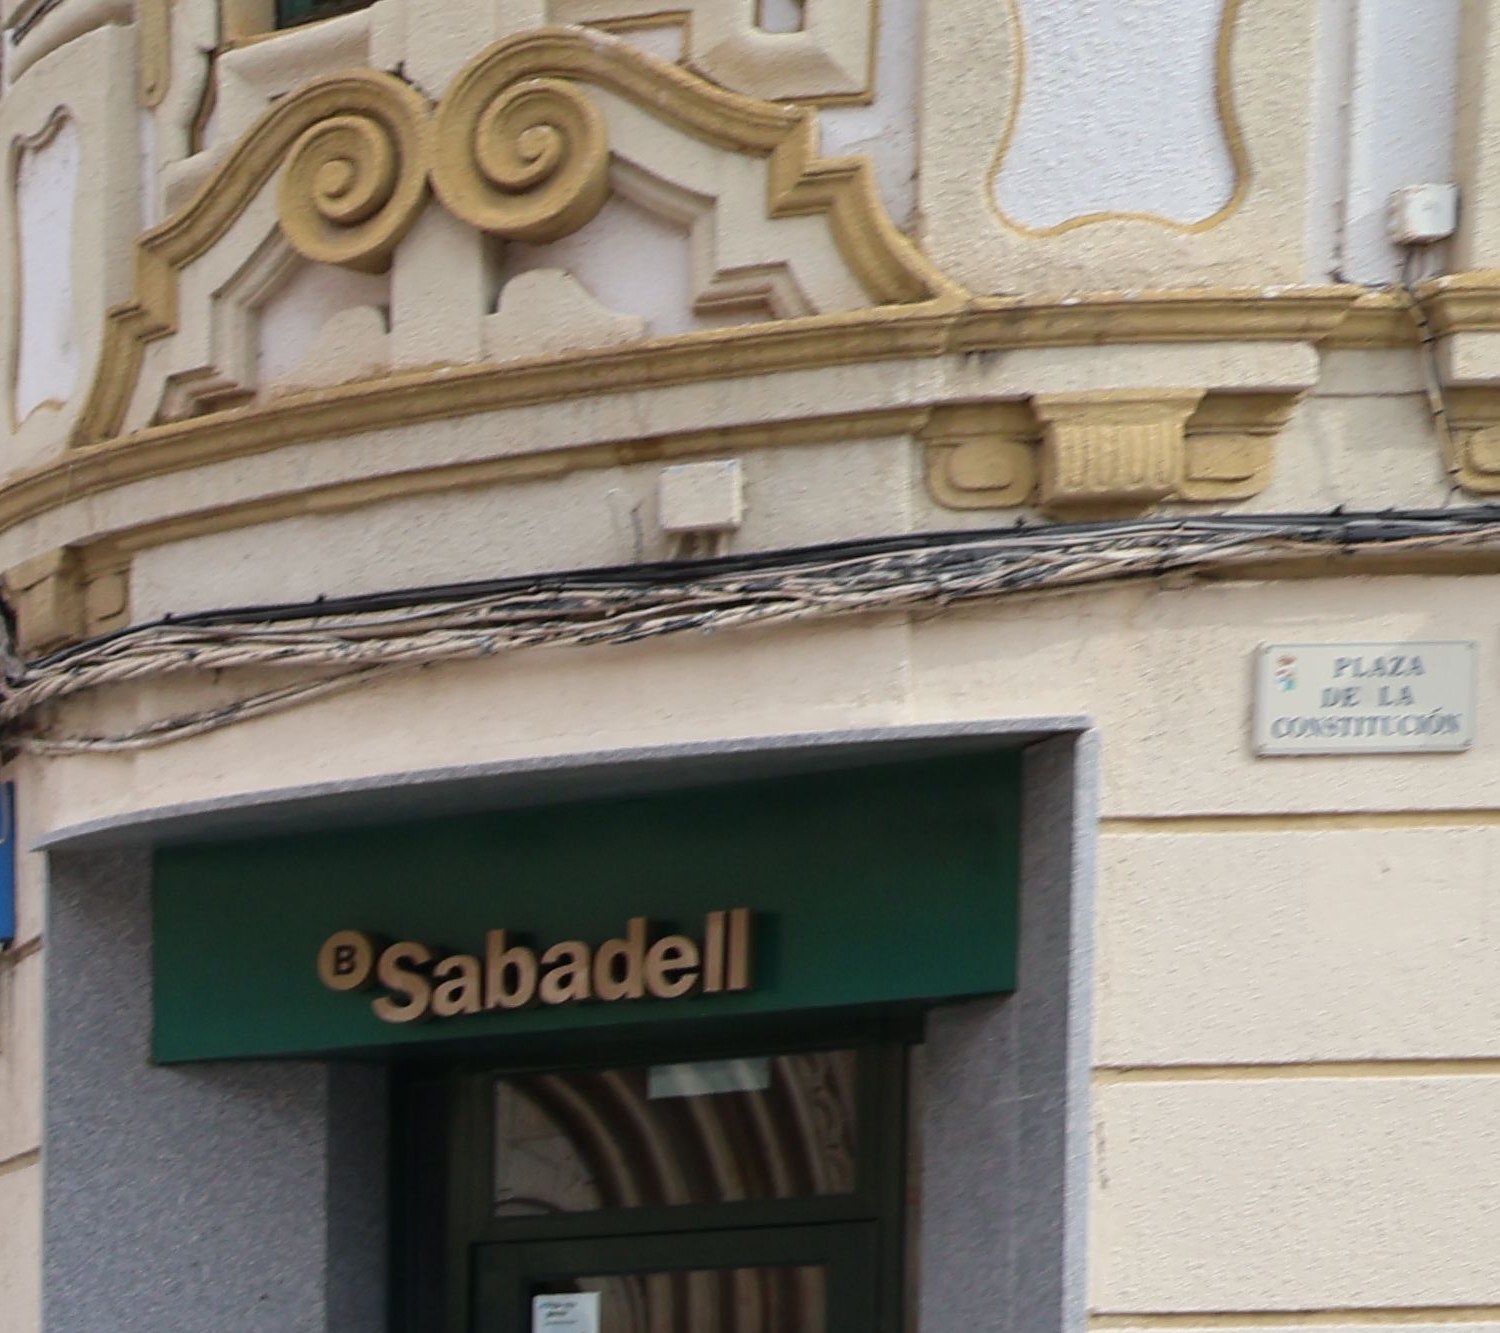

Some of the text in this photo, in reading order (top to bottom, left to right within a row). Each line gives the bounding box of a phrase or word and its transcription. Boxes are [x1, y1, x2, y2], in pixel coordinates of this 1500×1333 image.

[1333, 655, 1427, 678] PLAZA
[1321, 685, 1414, 707] DE LA
[1270, 707, 1462, 739] CONSTITUCIÓN
[372, 908, 751, 1023] Sabadell
